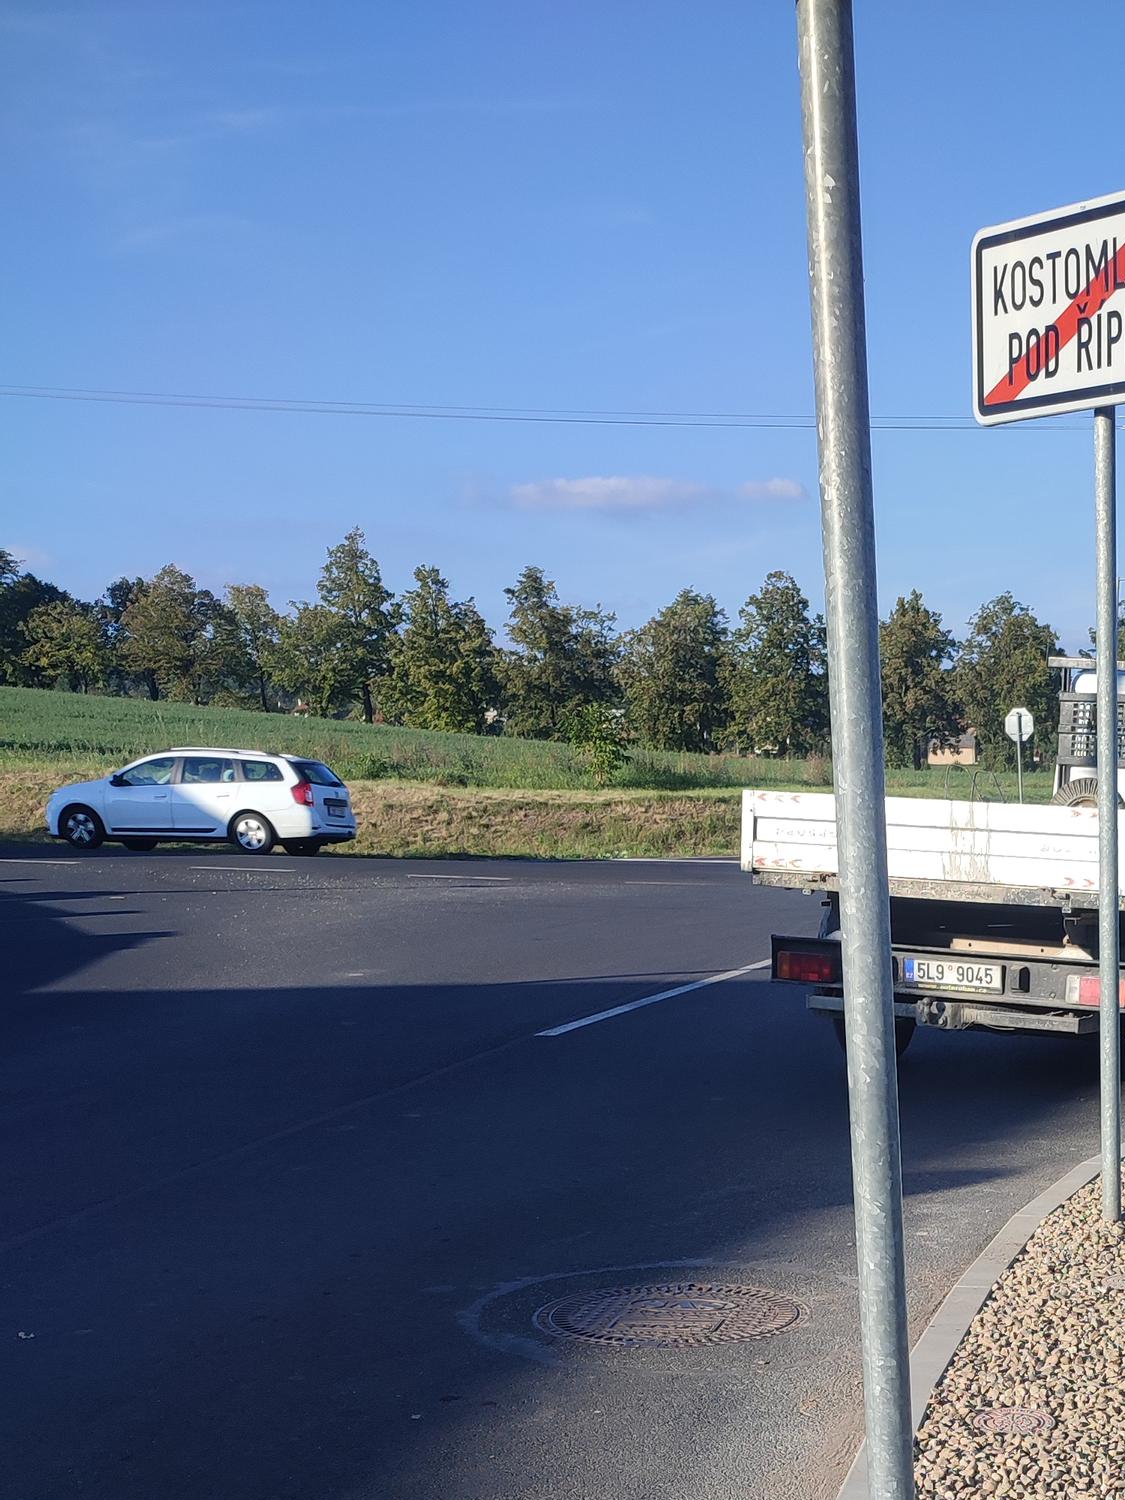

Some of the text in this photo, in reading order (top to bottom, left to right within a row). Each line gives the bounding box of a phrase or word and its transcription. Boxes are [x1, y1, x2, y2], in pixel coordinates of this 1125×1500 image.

[1008, 324, 1060, 386] POD
[917, 962, 993, 985] 5L9 9045
